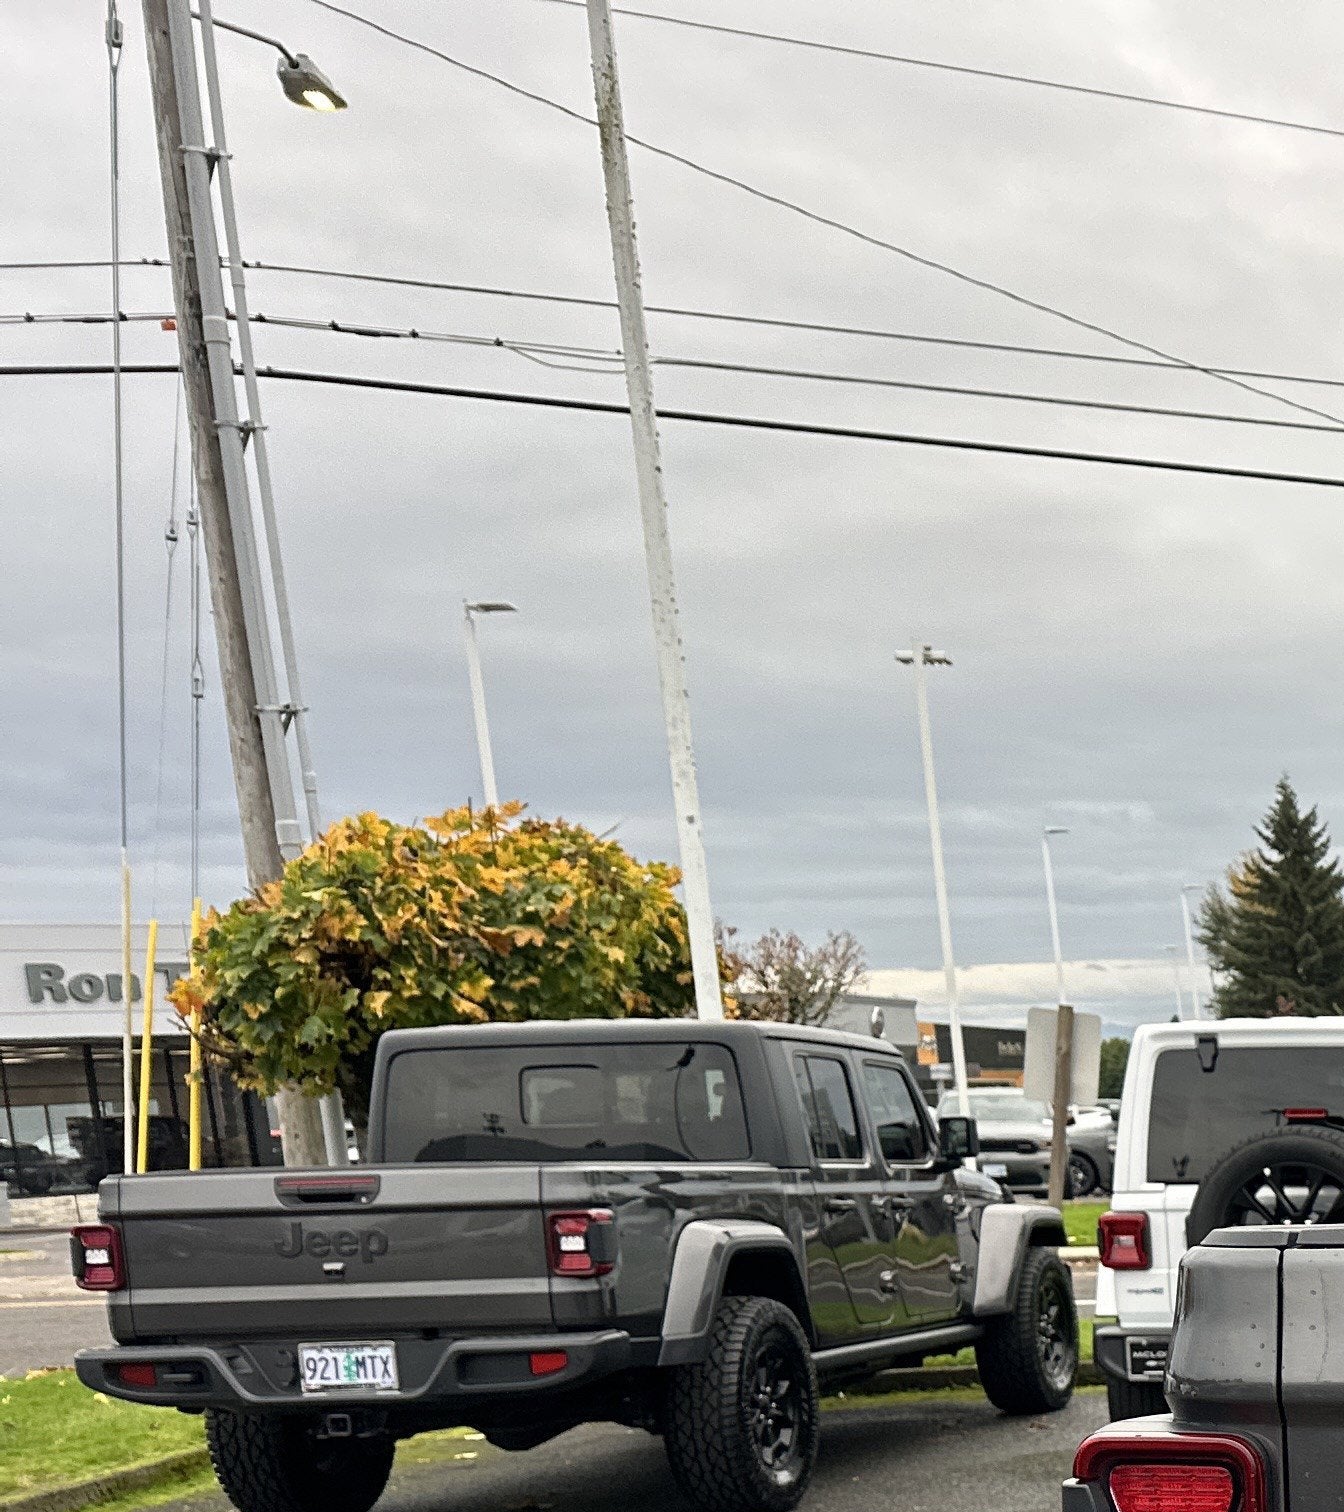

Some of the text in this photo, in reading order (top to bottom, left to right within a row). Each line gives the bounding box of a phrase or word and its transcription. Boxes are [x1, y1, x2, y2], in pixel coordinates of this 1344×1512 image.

[25, 962, 143, 1003] Ron
[274, 1221, 389, 1264] Jeep
[305, 1354, 393, 1381] 921 MTX
